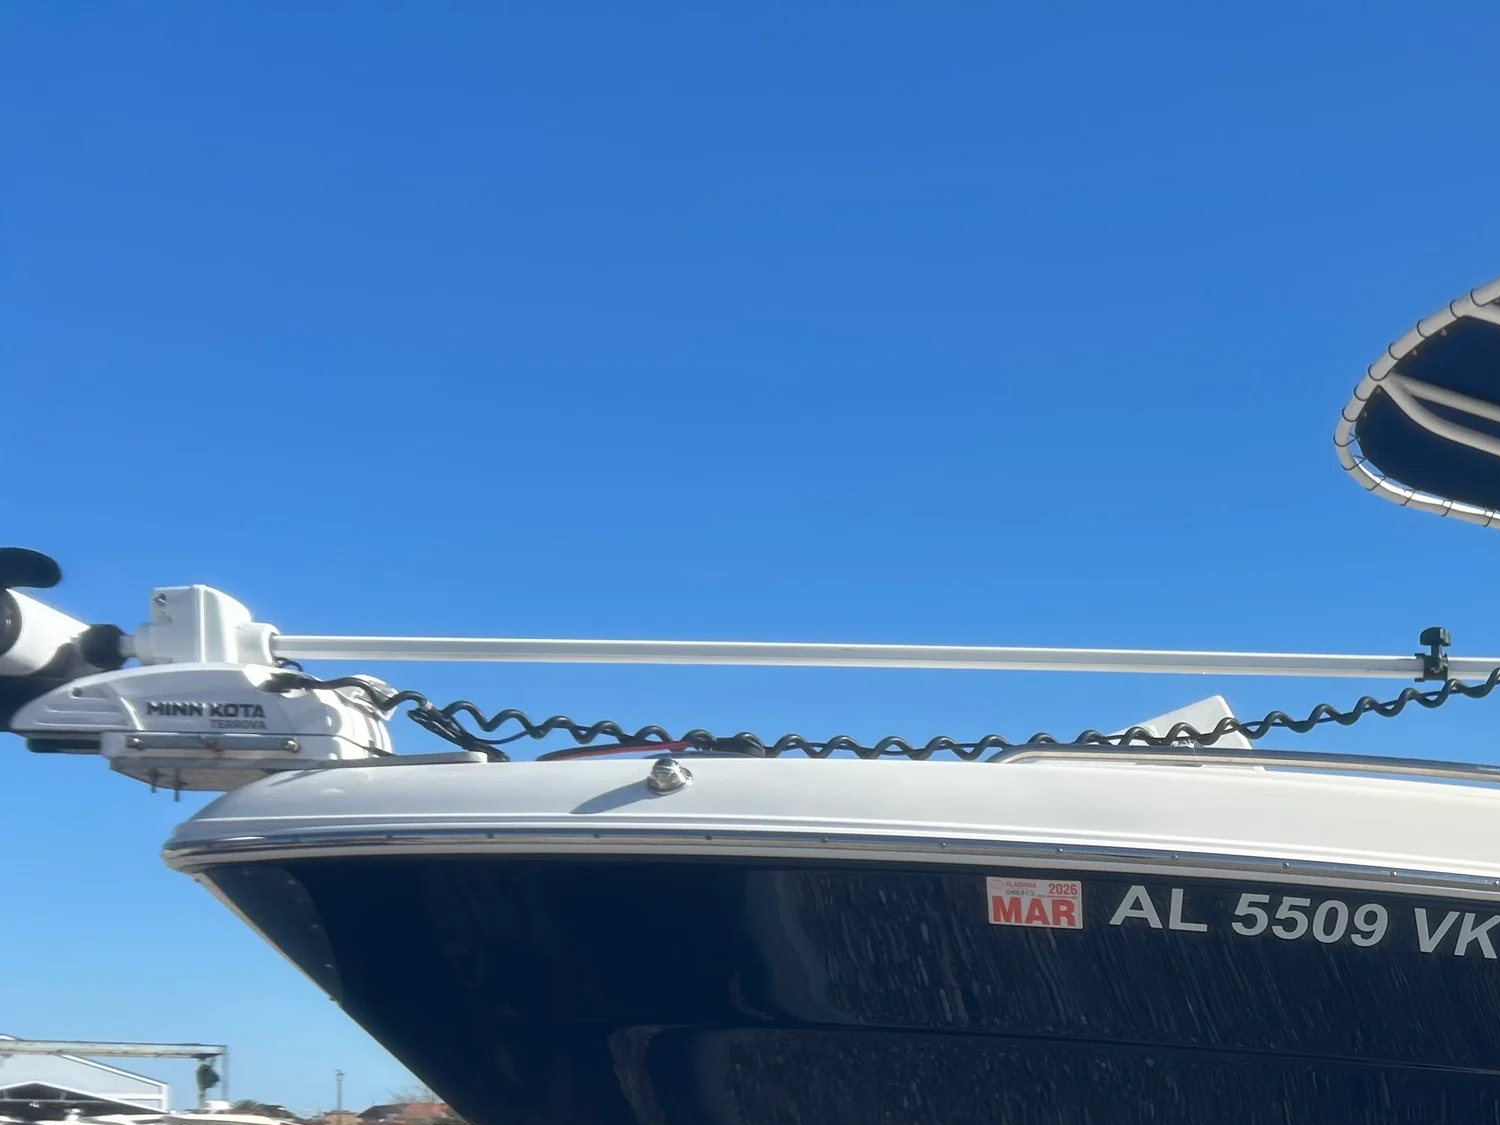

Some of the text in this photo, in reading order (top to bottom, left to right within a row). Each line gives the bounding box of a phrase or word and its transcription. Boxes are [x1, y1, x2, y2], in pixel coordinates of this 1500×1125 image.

[147, 701, 266, 719] MINN KOTA
[210, 719, 267, 730] TERROVA
[1006, 881, 1037, 889] ALABAMA
[1048, 883, 1078, 896] 2026
[991, 895, 1077, 927] MAR
[1109, 885, 1208, 932] AL
[1231, 892, 1389, 947] 5509
